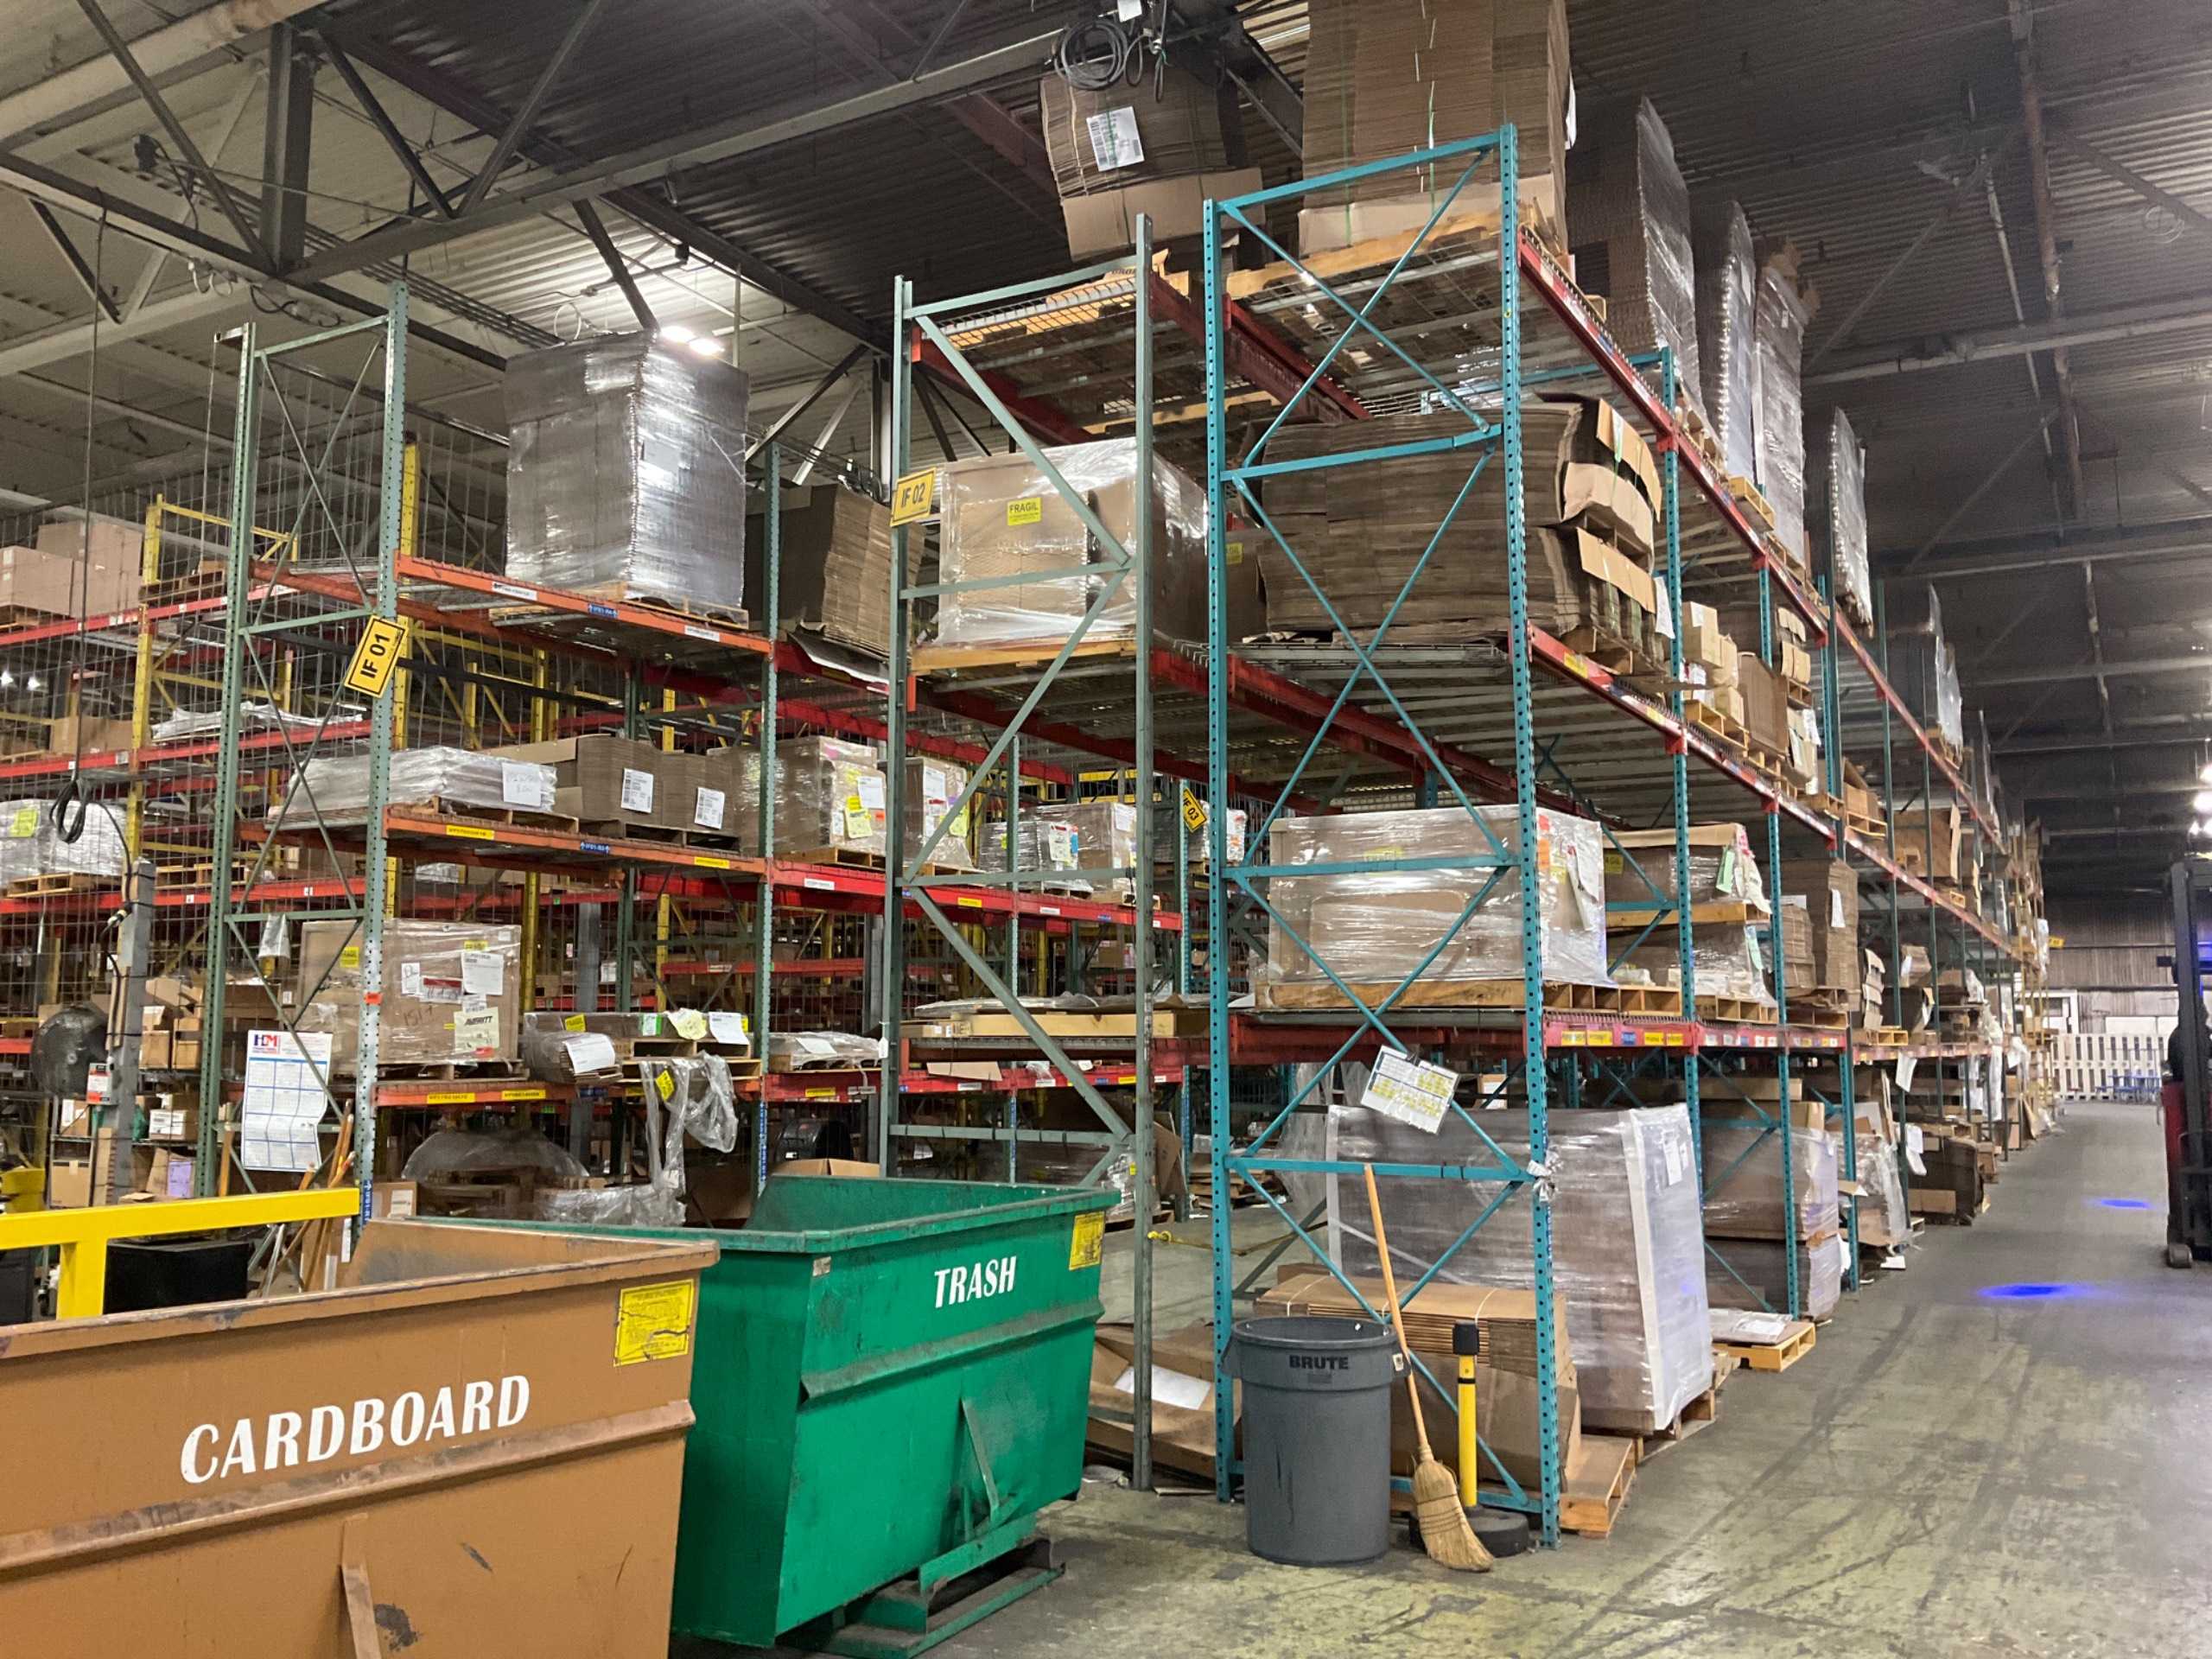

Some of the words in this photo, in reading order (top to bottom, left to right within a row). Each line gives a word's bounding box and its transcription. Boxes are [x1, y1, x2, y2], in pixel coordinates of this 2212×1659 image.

[901, 487, 912, 509] IF
[912, 482, 925, 505] 02
[359, 659, 378, 678] IF
[370, 633, 391, 657] 01
[1188, 808, 1199, 821] 03
[934, 1255, 1017, 1308] TRASH
[1289, 1355, 1349, 1370] BRUTE
[180, 1375, 531, 1484] CARDBOARD
